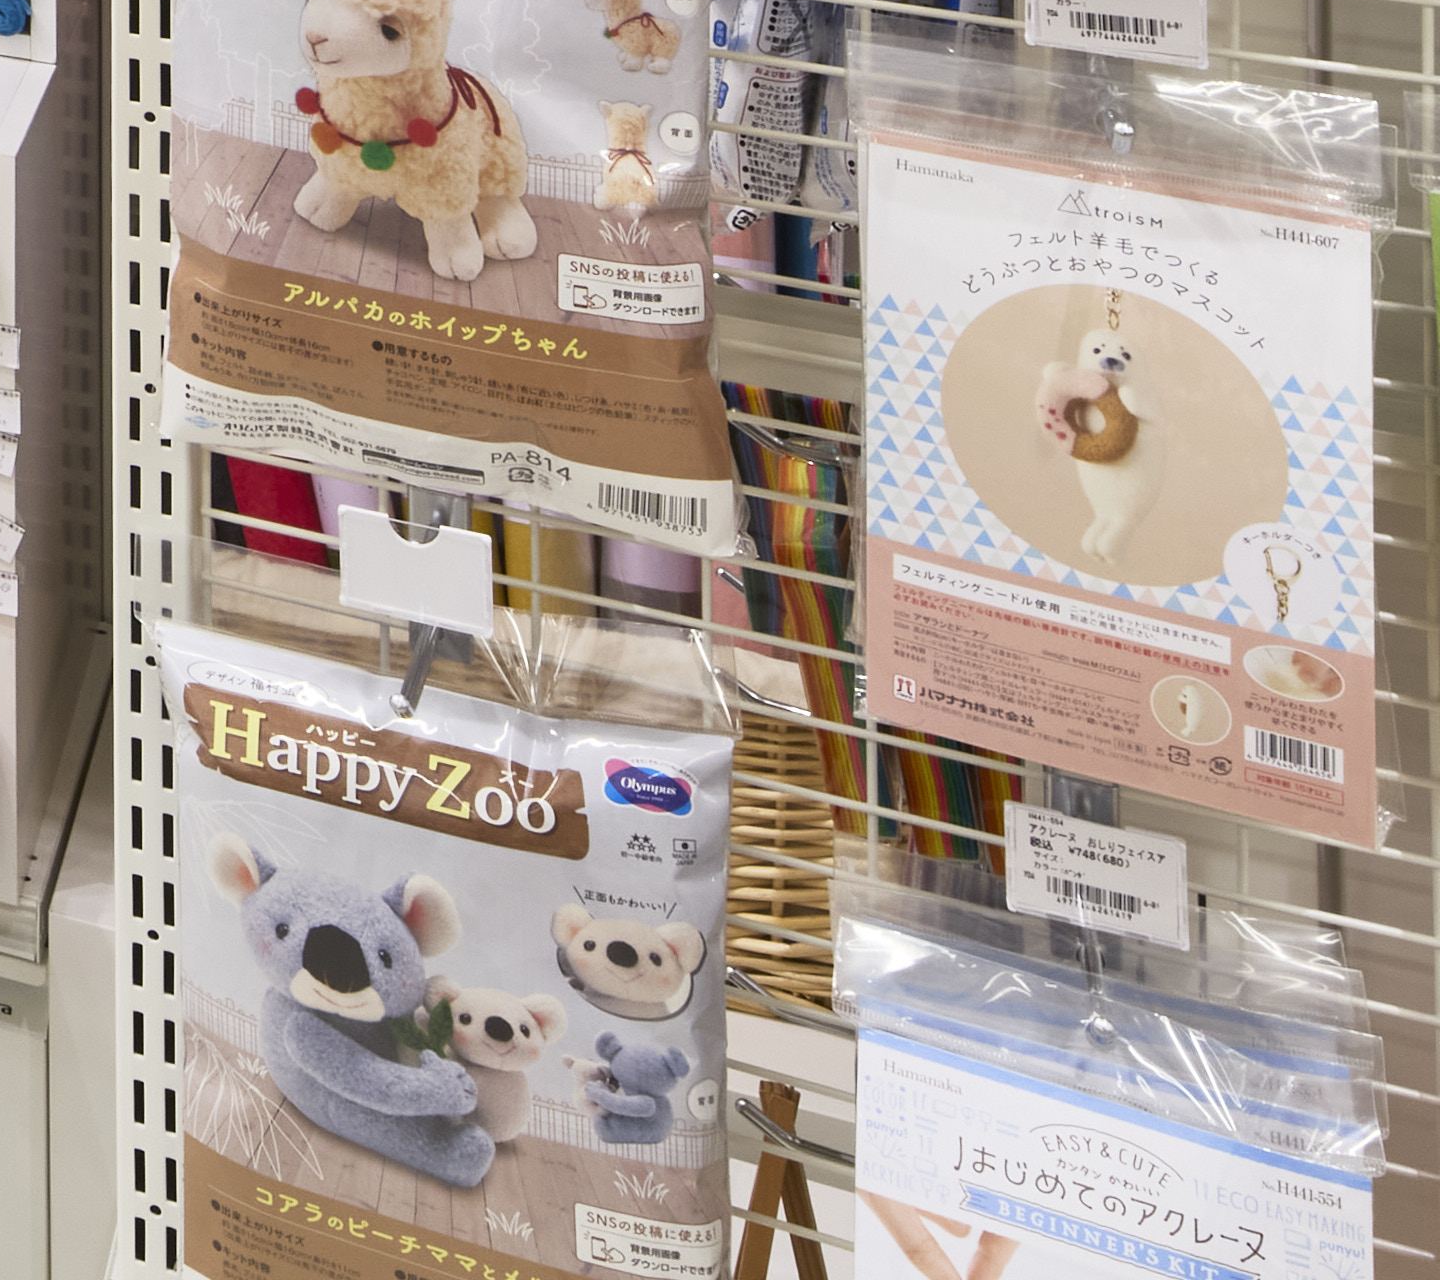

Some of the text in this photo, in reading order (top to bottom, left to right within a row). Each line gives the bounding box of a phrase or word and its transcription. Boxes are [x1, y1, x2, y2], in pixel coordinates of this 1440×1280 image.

[895, 158, 975, 184] Hamanaka
[569, 261, 695, 283] SNSの投稿に使える!
[1008, 229, 1218, 287] フェルト羊毛でつくる
[283, 281, 588, 361] アルパカのホイップちゃん
[612, 302, 700, 318] ダウンロードできます!
[961, 254, 1267, 351] どうぶつとおやつのマスコット
[490, 449, 571, 483] PA-814
[1242, 531, 1323, 560] キーホルダーつき
[899, 563, 1060, 614] フェルティングニードル使用
[919, 688, 1034, 727] ハマナカ株式会社
[307, 723, 376, 747] ハッピー
[208, 699, 556, 834] Happy Zoo
[620, 776, 677, 798] Olympus
[1069, 846, 1130, 868] ¥748(680)
[584, 890, 668, 913] 正面もかわいい!
[882, 1060, 963, 1096] Hamanaka
[1043, 1134, 1173, 1189] EASY & CUTE
[1055, 1158, 1161, 1198] カンタン かわいい
[954, 1136, 1266, 1263] はじめてのアクレーヌ
[1217, 1190, 1366, 1243] ECO EASY MAKING
[587, 1212, 716, 1243] SNSの投稿に使える!
[997, 1200, 1219, 1280] BEGINNER'S KIT
